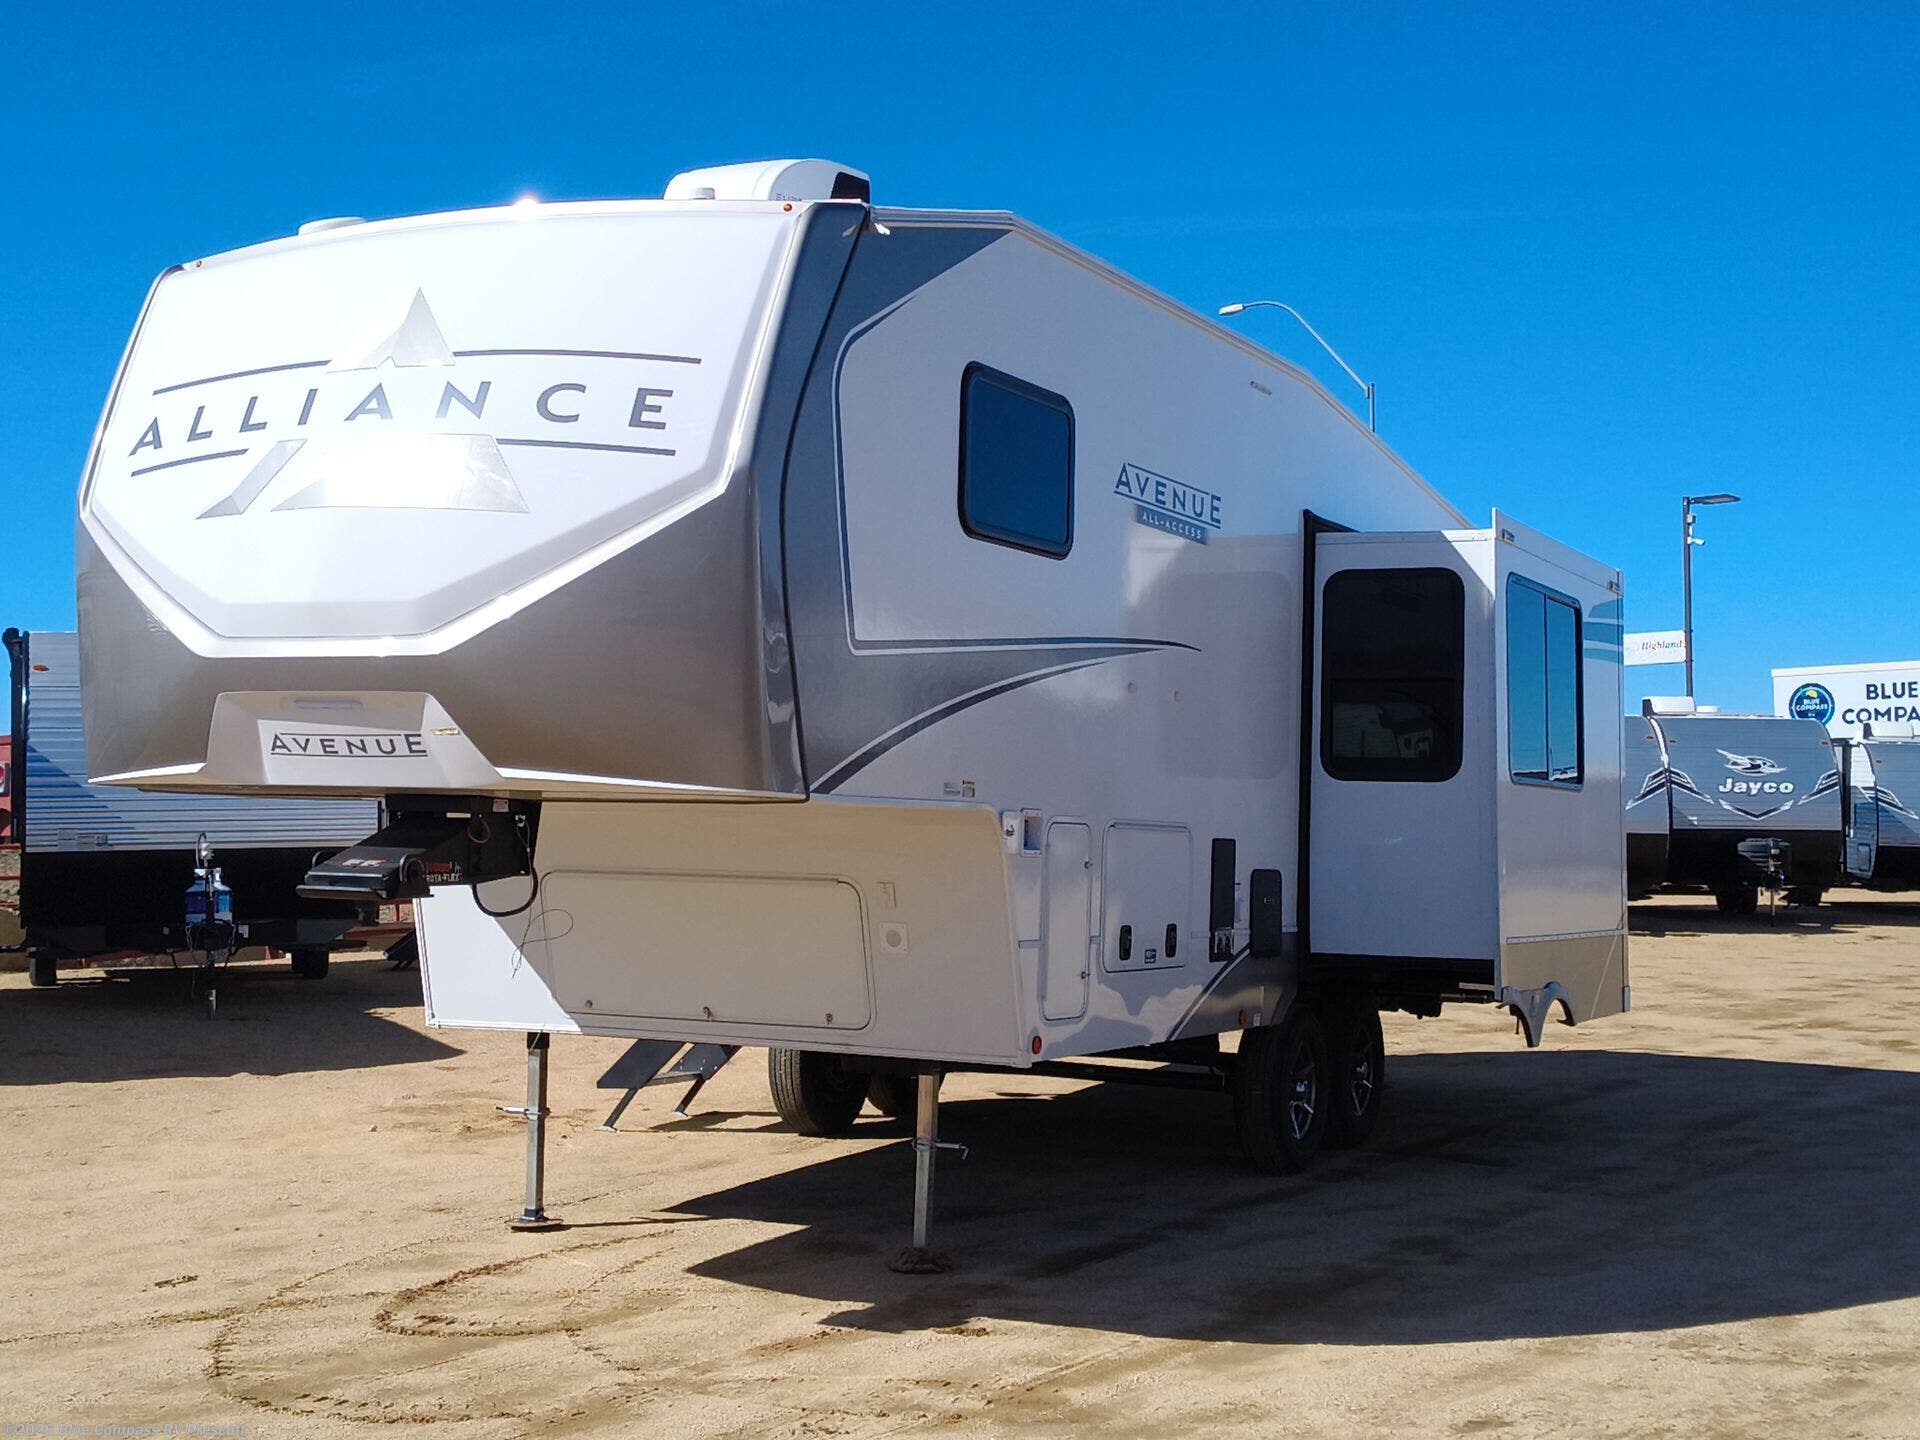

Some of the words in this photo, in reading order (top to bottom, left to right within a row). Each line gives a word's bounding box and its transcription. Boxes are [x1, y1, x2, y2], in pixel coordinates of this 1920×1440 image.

[128, 380, 674, 456] ALLIANCE
[1115, 462, 1221, 525] AVENUE
[1142, 511, 1202, 540] ALL-ACCESS
[1641, 640, 1683, 651] Highland
[1866, 682, 1919, 700] BLUE
[271, 733, 428, 755] AVENUE
[1718, 778, 1794, 796] Jayco
